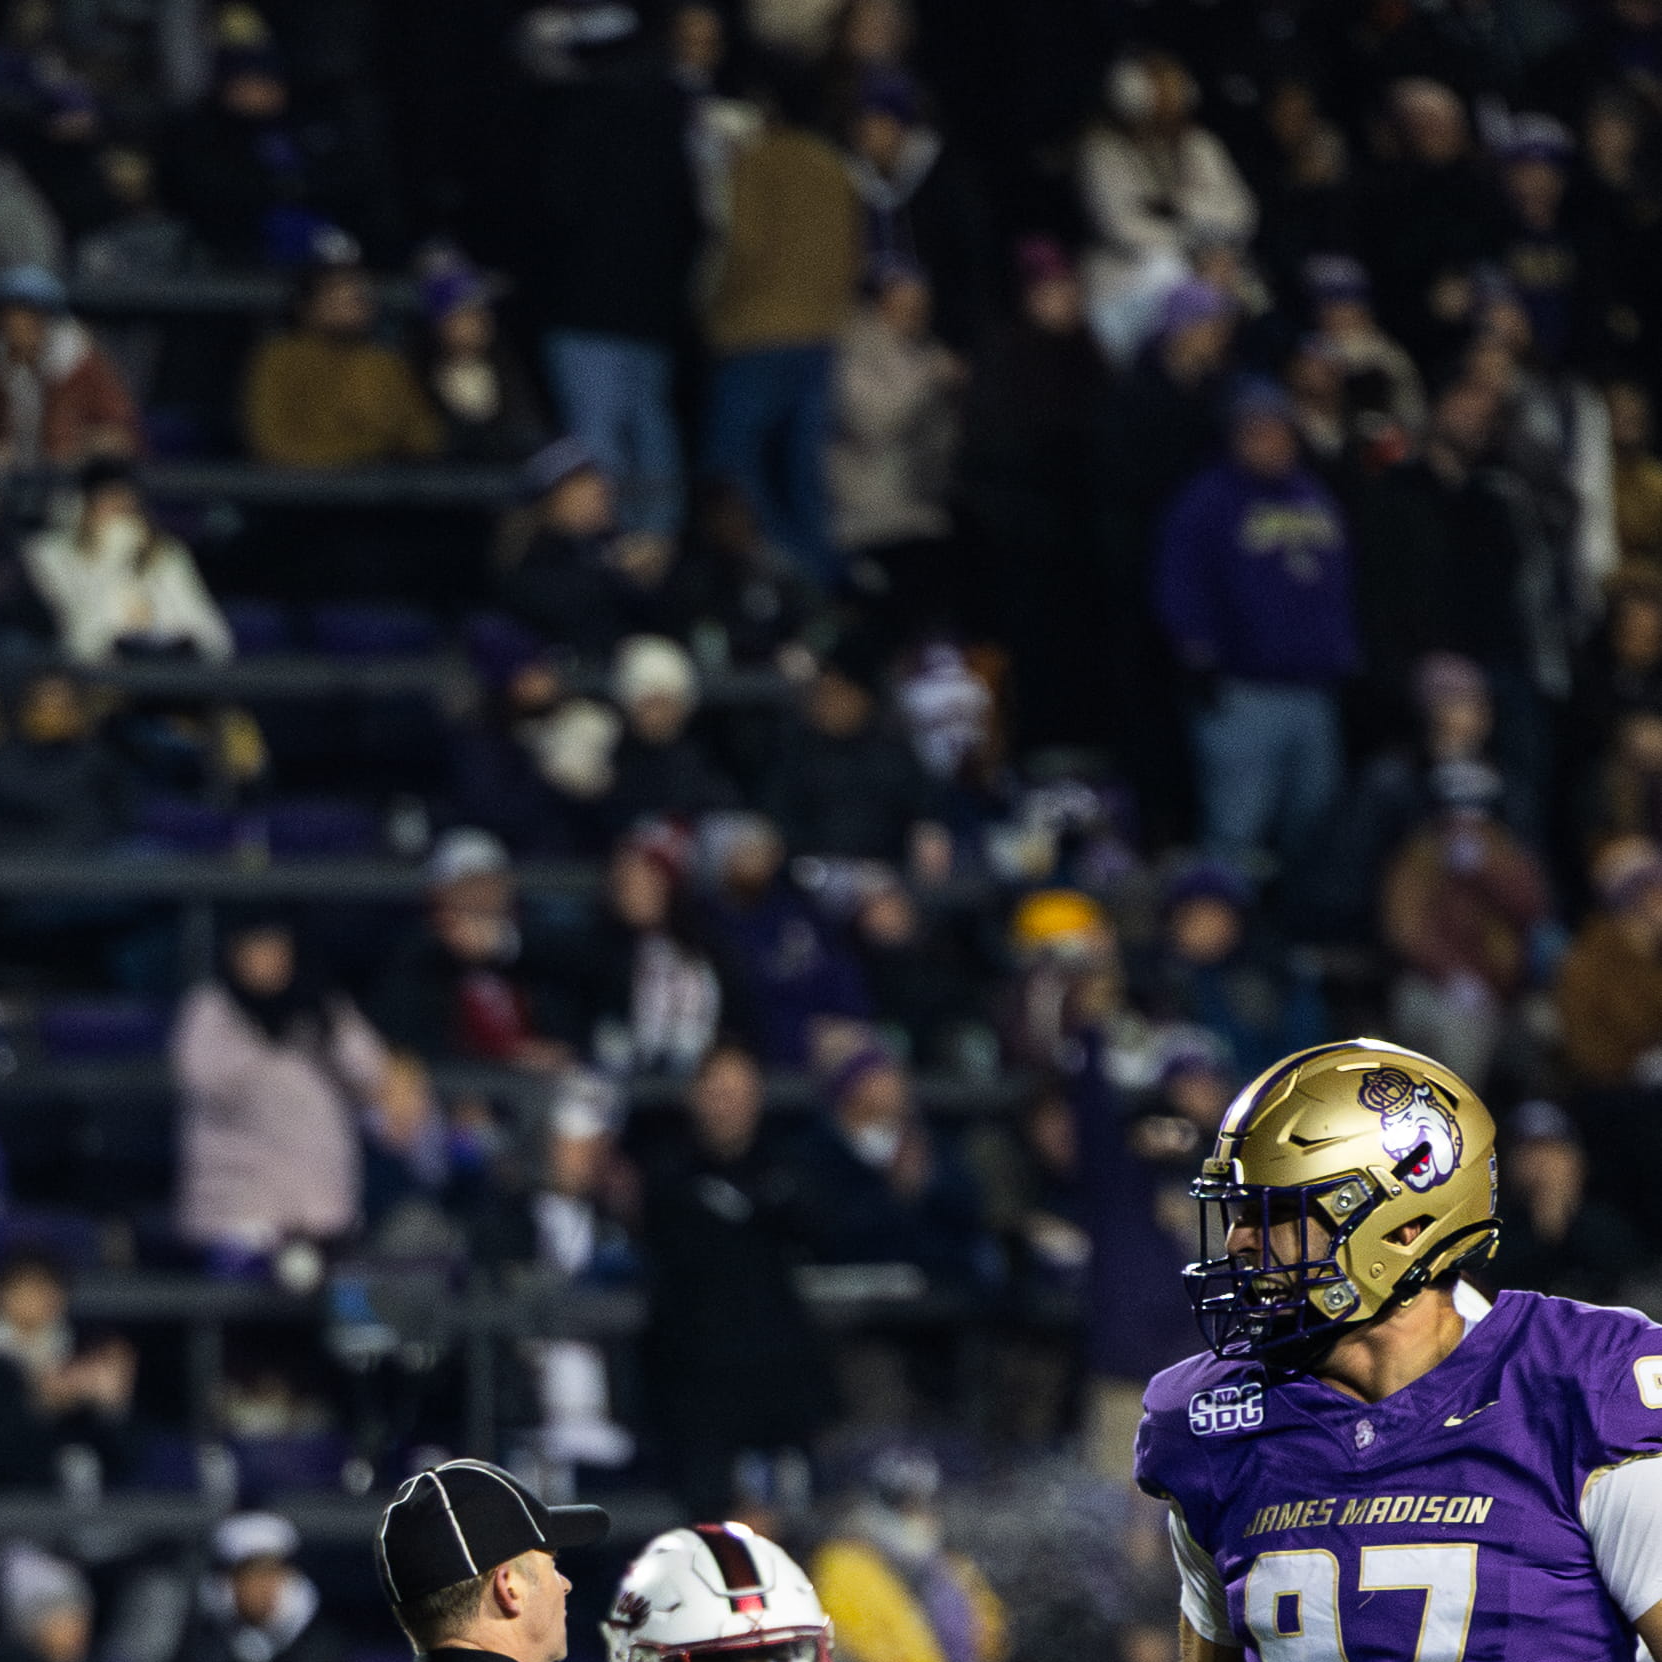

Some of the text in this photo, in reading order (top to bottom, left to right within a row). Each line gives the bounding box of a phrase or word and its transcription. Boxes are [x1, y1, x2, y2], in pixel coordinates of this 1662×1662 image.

[1189, 1382, 1263, 1436] SBC
[1243, 1496, 1493, 1538] JAMES MADISON
